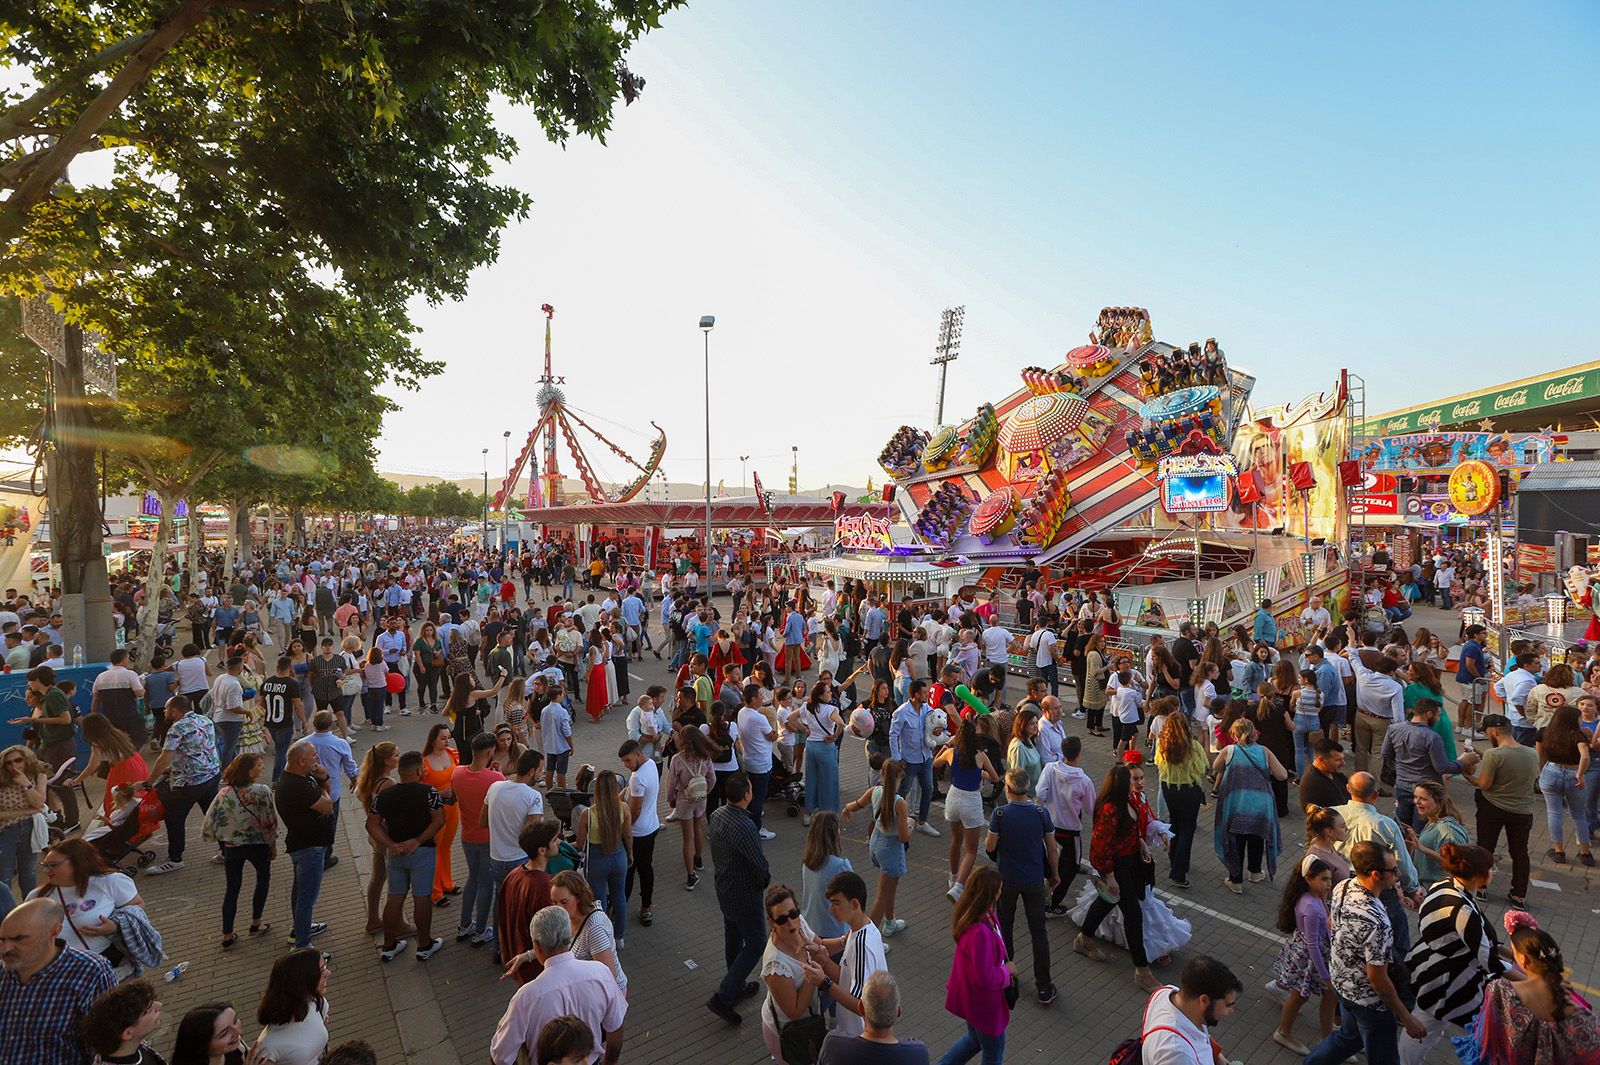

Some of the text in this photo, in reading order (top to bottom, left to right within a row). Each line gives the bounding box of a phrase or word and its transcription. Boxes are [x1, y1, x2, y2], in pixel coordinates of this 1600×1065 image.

[1391, 432, 1480, 446] GRAND PRIX
[1172, 495, 1185, 503] EL
[264, 682, 287, 694] KOJIRO
[265, 694, 285, 724] 10
